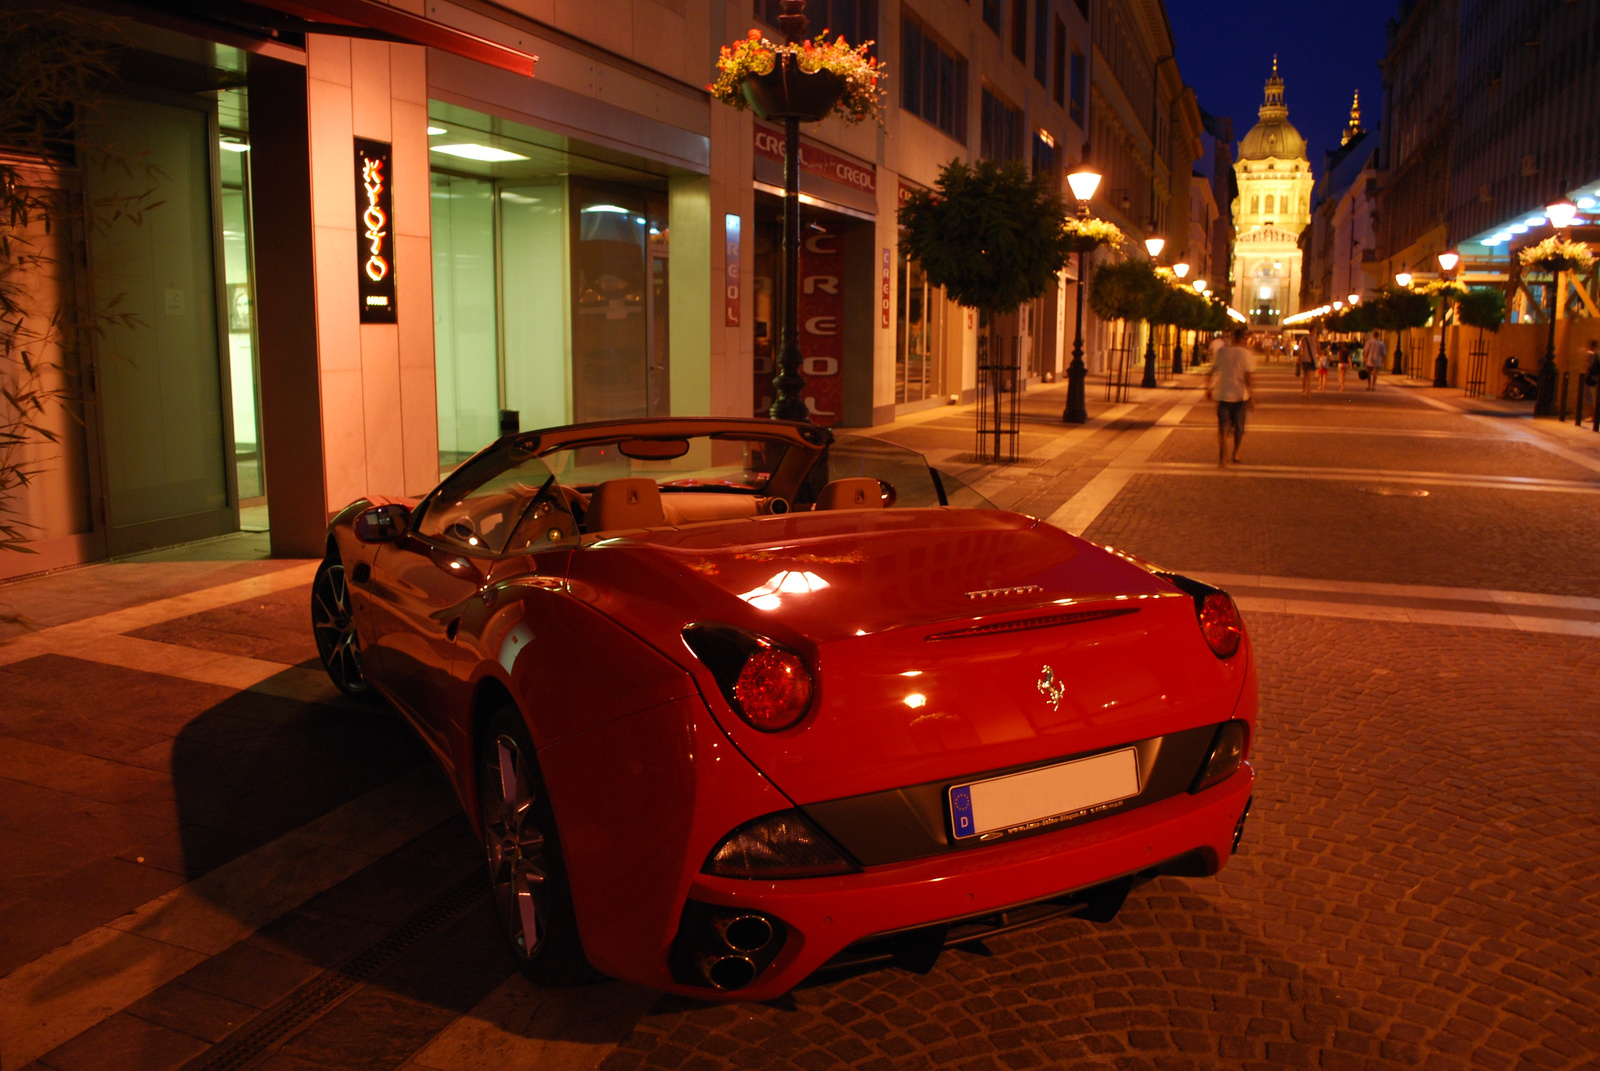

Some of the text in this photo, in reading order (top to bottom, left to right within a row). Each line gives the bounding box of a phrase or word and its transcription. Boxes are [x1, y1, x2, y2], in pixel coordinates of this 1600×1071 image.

[755, 132, 809, 165] CREL
[836, 162, 876, 190] CREOL
[363, 158, 389, 281] KYOTO
[727, 239, 739, 323] REOL
[882, 252, 890, 326] CREOL
[803, 234, 839, 416] CREOL
[960, 816, 969, 828] D
